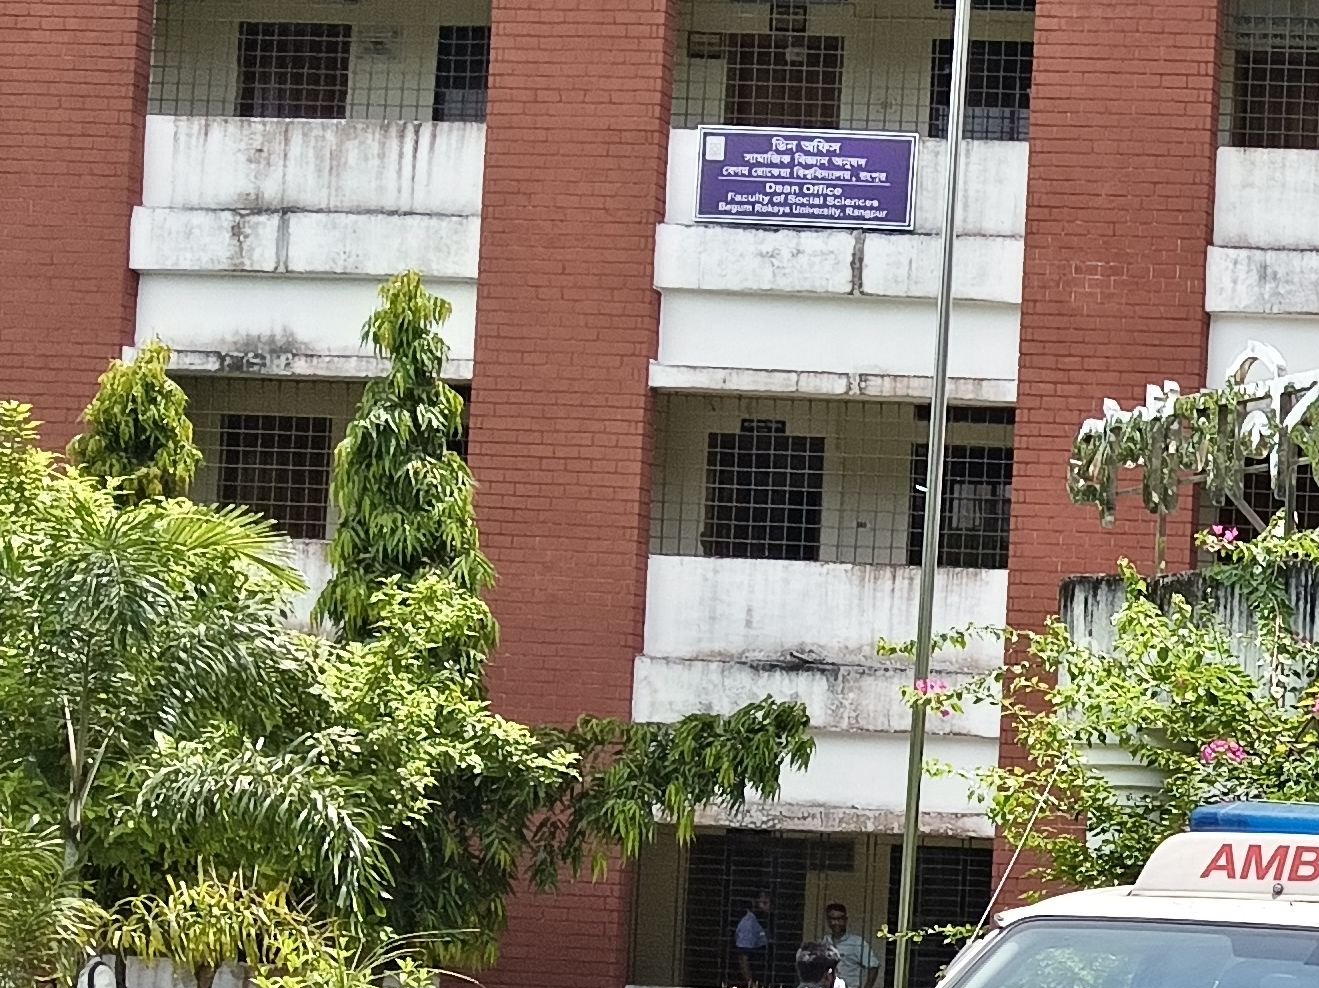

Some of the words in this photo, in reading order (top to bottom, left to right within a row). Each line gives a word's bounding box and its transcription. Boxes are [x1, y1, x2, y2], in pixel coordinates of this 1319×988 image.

[772, 137, 798, 151] ডিন
[801, 139, 842, 153] অফিস
[744, 151, 791, 164] সামাজিক
[766, 183, 799, 193] Dean
[803, 184, 842, 196] Office
[727, 192, 770, 204] Faculty
[773, 194, 785, 203] of
[787, 194, 823, 205] Social
[826, 196, 879, 207] Sciences
[718, 202, 753, 214] Begum
[754, 203, 790, 216] Rokeya
[846, 207, 887, 218] Rangpur
